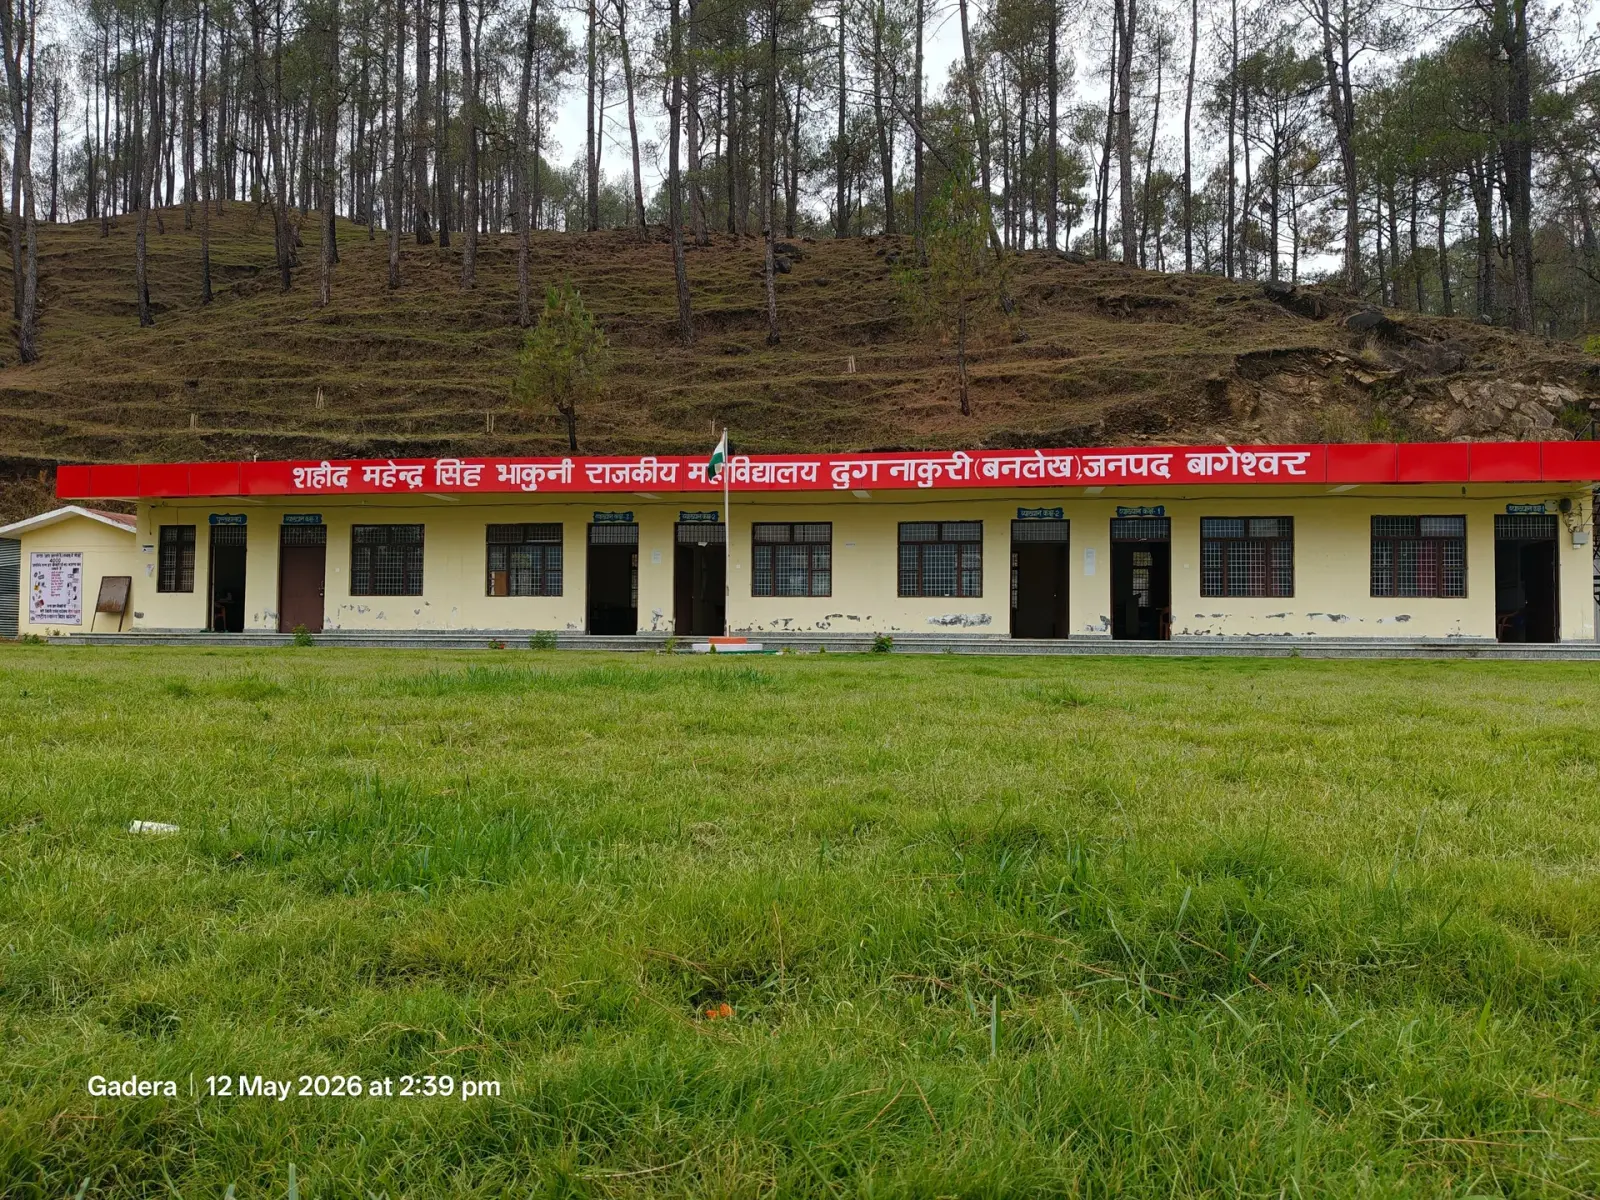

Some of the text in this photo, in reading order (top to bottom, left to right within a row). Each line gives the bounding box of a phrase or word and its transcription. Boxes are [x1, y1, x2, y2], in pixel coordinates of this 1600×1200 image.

[292, 460, 352, 489] शहीद
[361, 459, 426, 490] महेन्द्र
[433, 458, 486, 487] सिंह
[495, 457, 576, 492] भाकुनी
[584, 456, 680, 484] राजकीय
[687, 456, 821, 485] मविद्यालय
[1184, 446, 1311, 477] बागेश्वर
